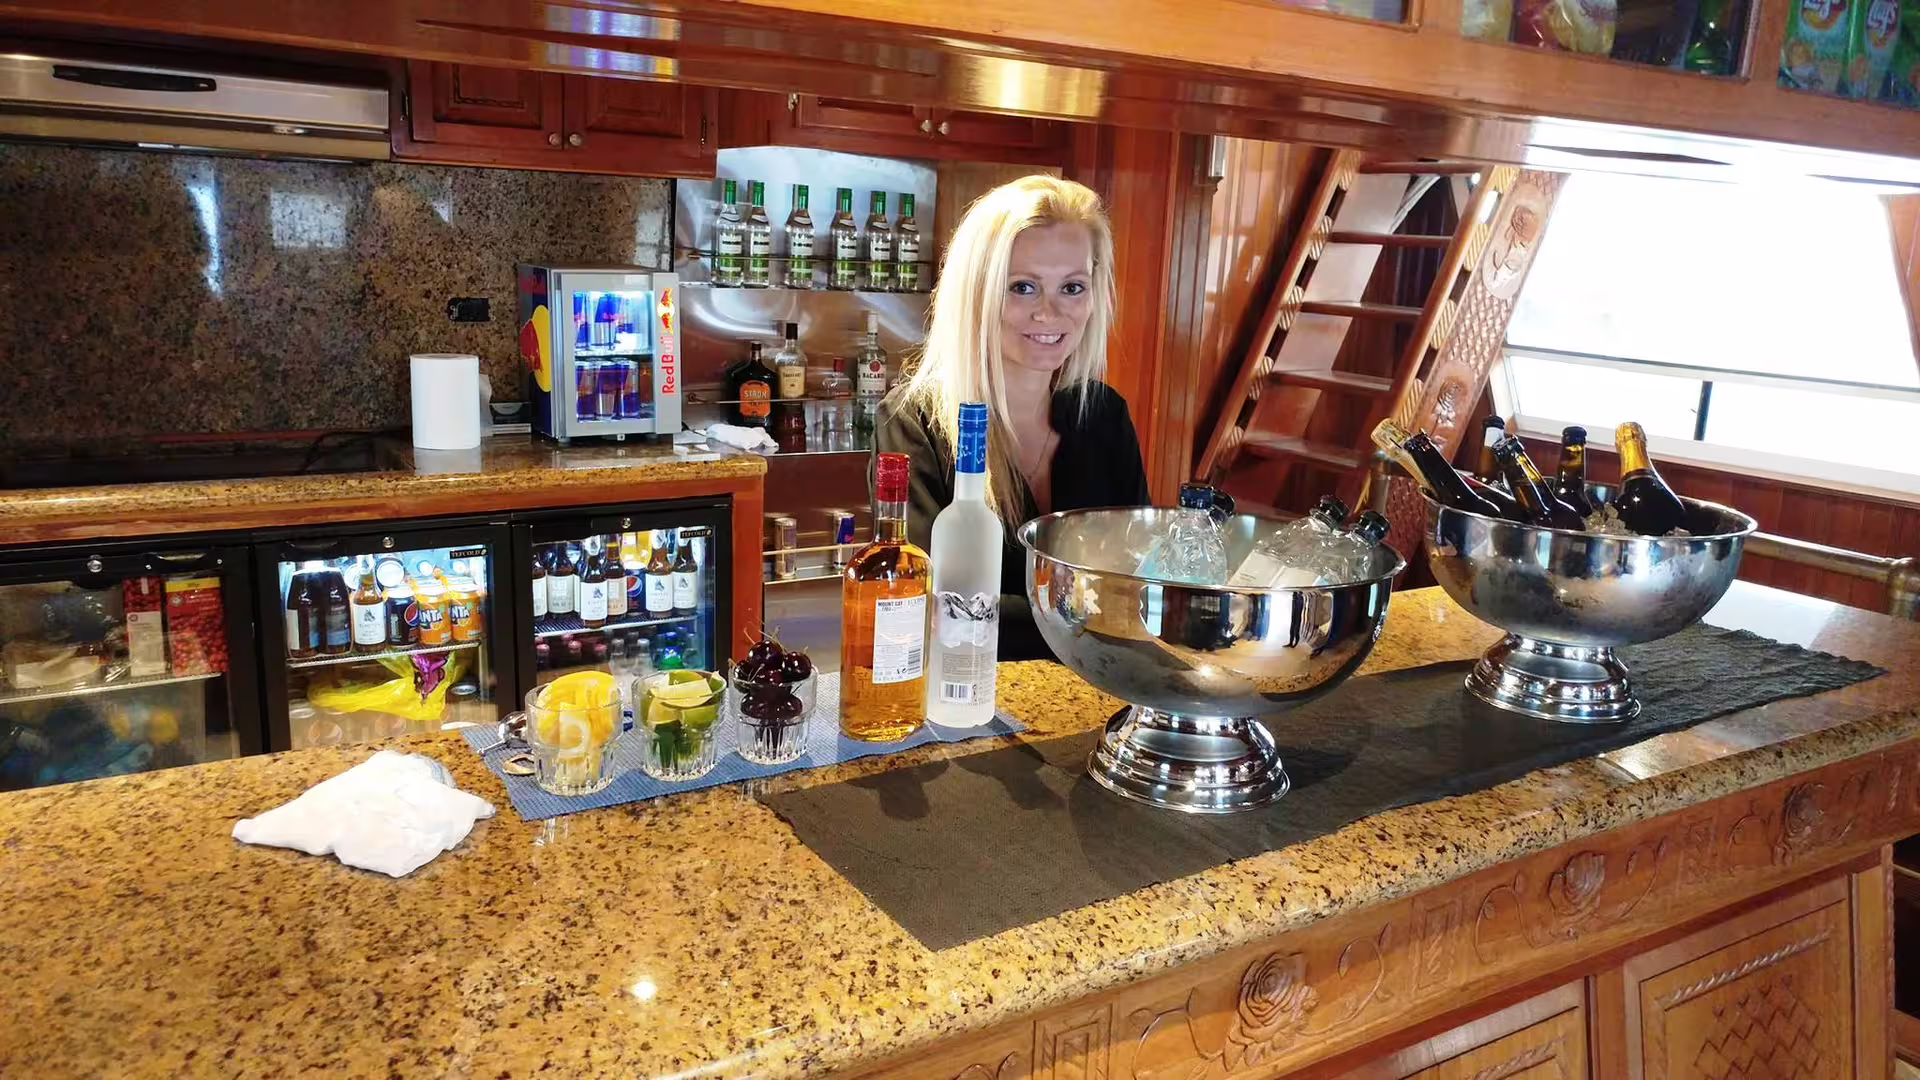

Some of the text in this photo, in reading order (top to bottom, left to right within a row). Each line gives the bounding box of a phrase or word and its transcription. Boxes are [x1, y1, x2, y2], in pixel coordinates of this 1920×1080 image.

[661, 335, 675, 394] Red Bull
[418, 610, 442, 622] ANTA
[449, 606, 470, 618] NTA
